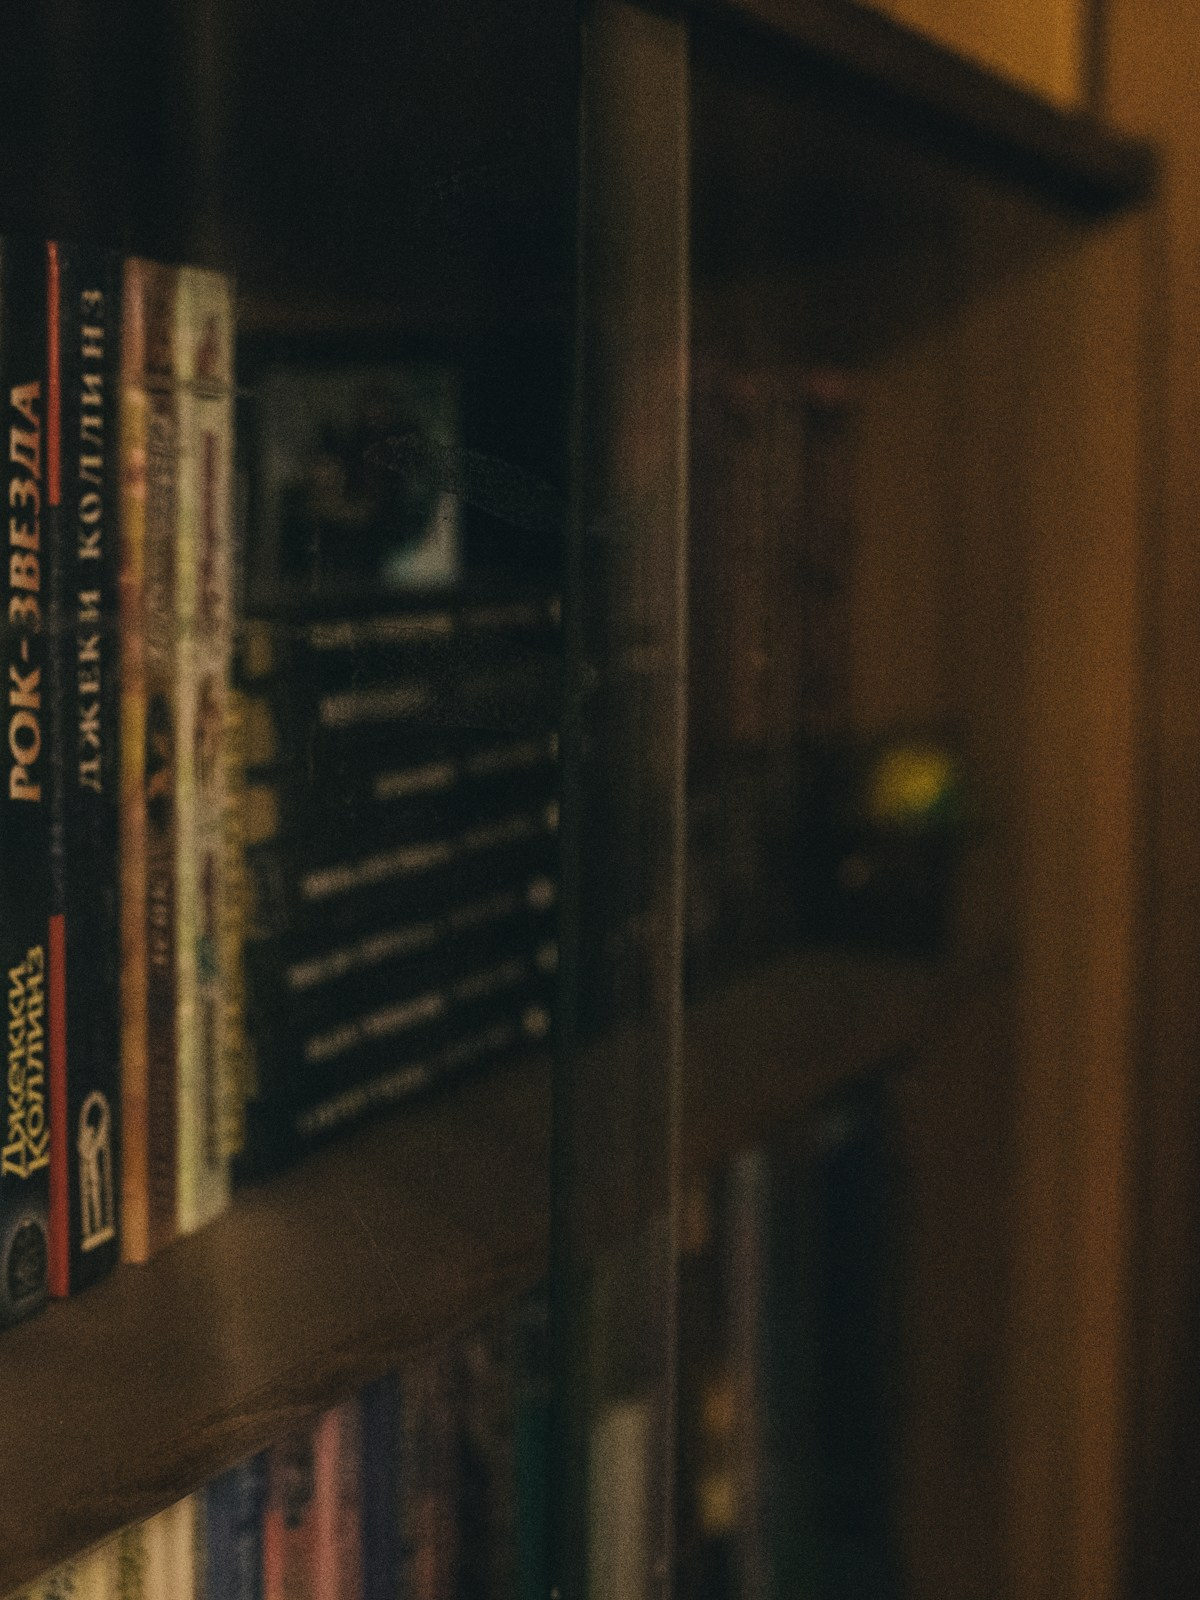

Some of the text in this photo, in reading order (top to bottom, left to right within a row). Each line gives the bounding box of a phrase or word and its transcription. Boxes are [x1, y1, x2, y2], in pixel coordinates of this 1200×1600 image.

[79, 288, 105, 560] КОЛЛИНЗ
[9, 380, 42, 802] РОК-ЗВЕЗДА
[1, 963, 27, 1179] Джекки
[21, 945, 51, 1169] Коллинз
